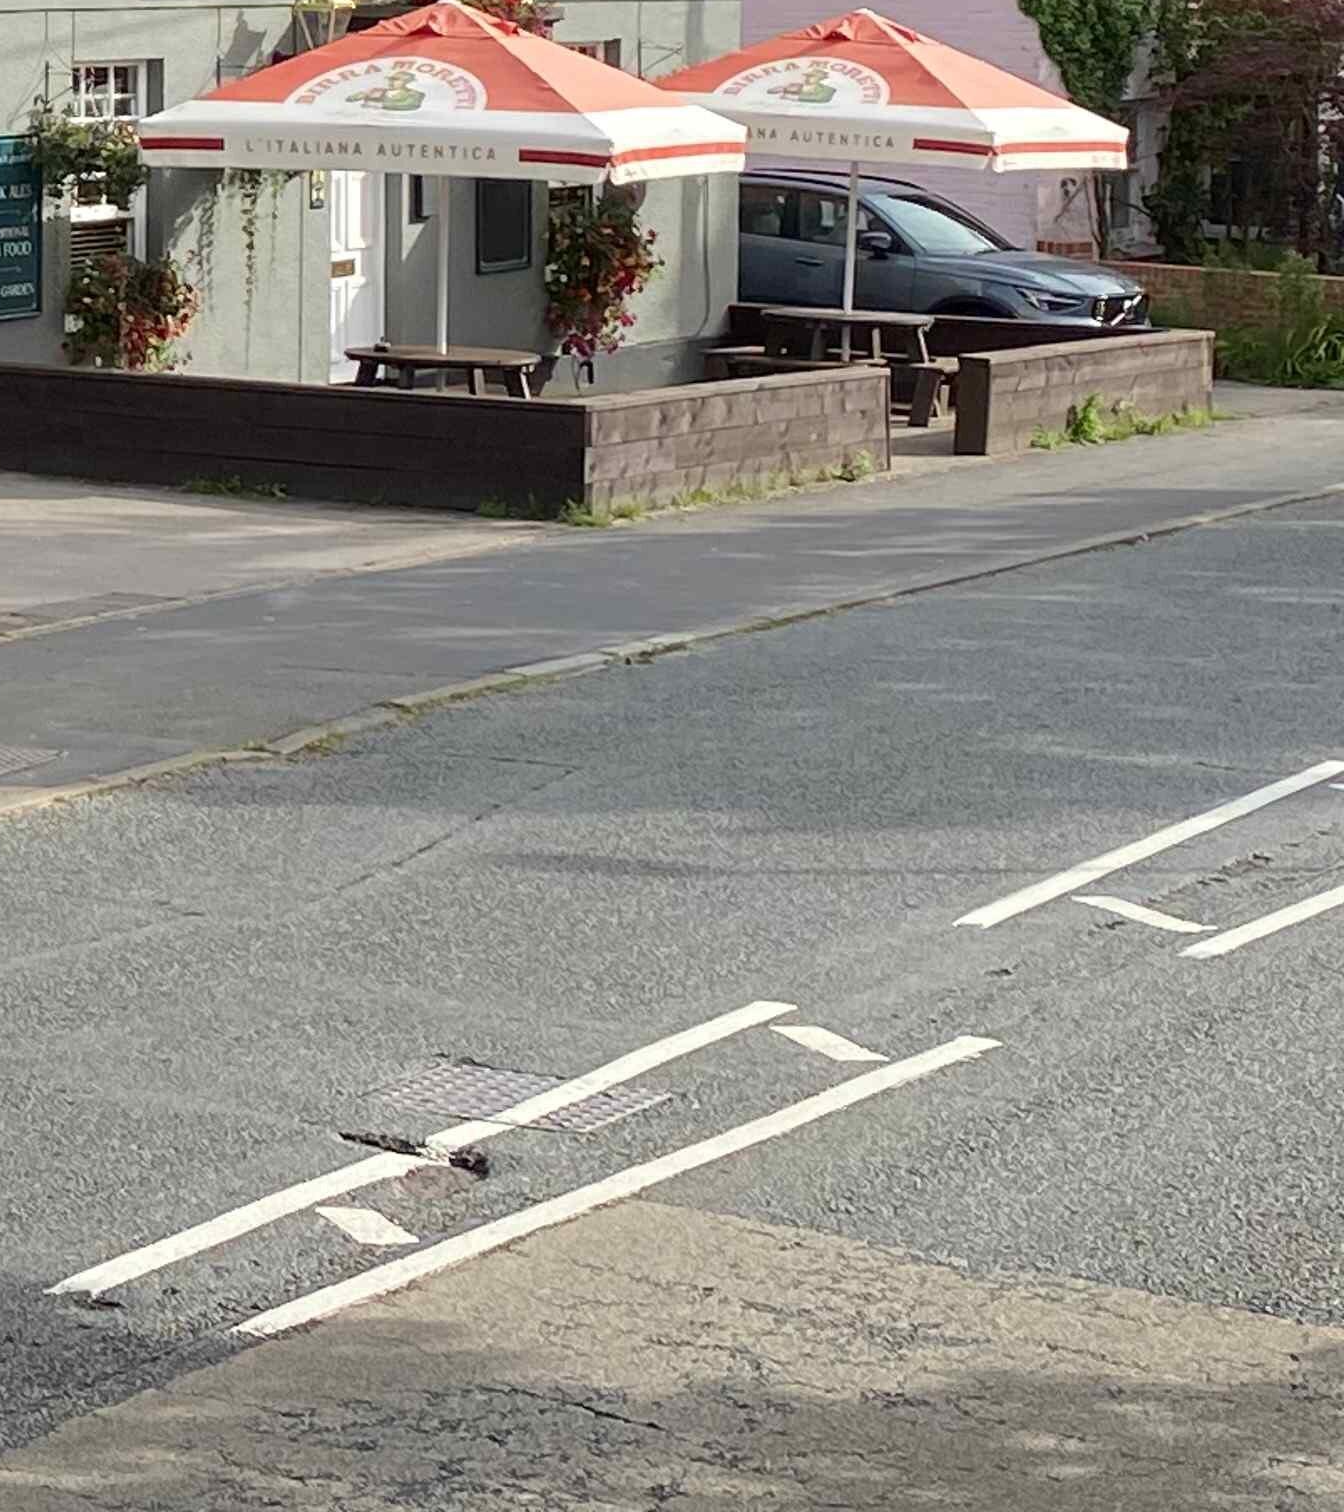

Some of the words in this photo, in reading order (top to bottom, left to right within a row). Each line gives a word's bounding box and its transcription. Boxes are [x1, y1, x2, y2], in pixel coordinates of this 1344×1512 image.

[295, 63, 382, 105] BIRRA
[391, 61, 478, 111] MORETTI
[790, 130, 895, 149] AUTENTICA
[245, 138, 363, 155] L'ITALIANA
[376, 143, 497, 161] AUTENTICA
[9, 183, 32, 199] ALES
[3, 240, 32, 257] FOOD
[0, 281, 35, 299] GARDEN
